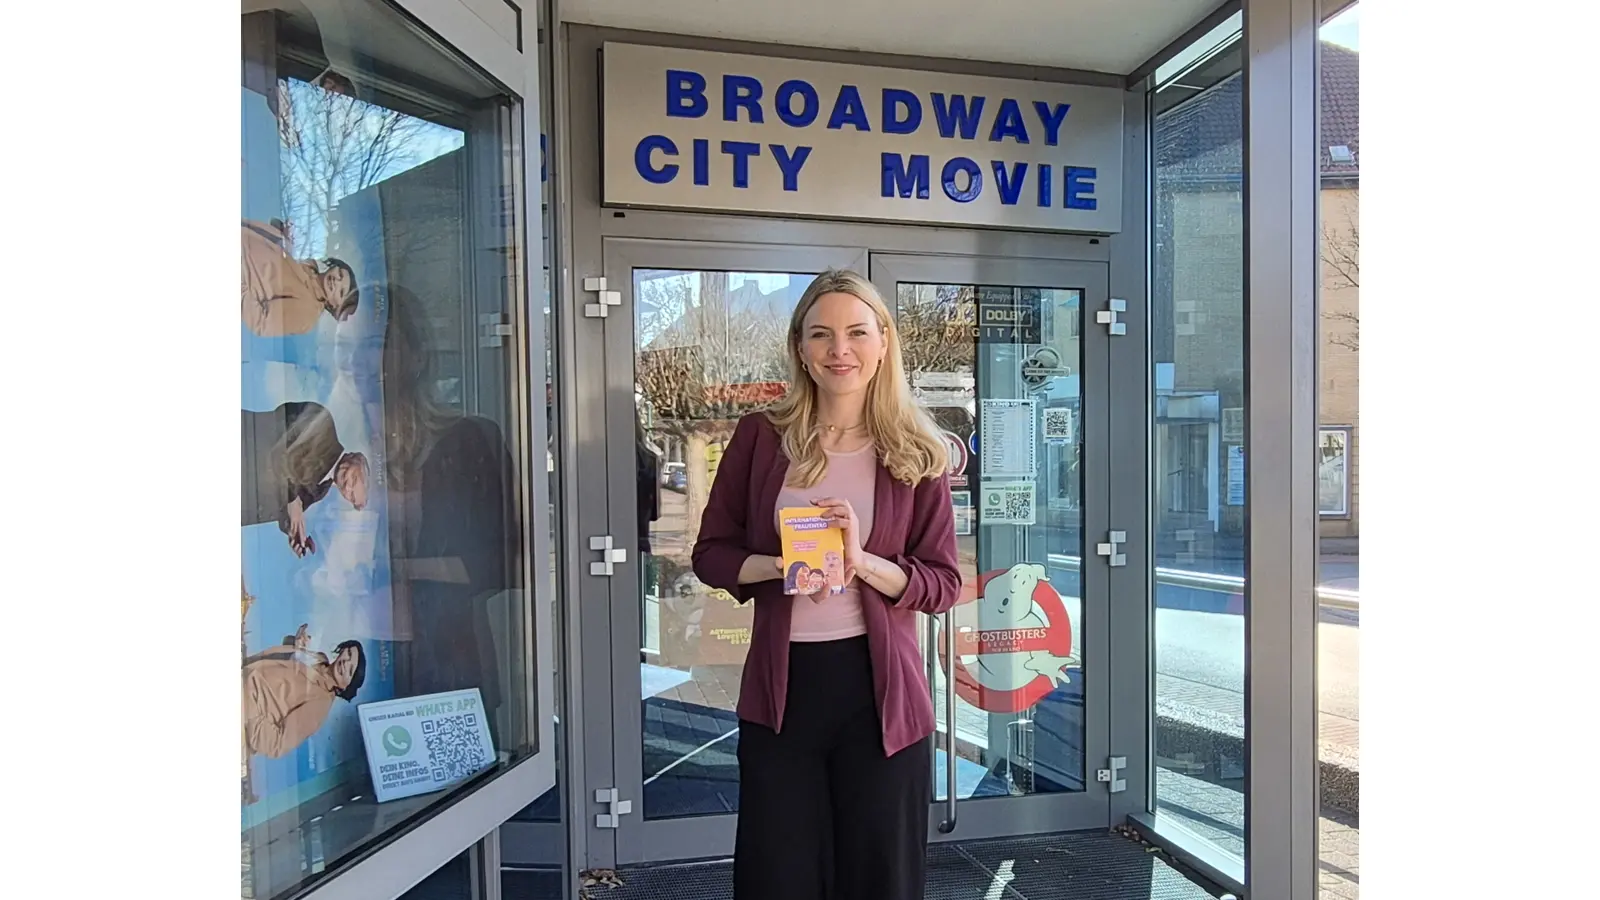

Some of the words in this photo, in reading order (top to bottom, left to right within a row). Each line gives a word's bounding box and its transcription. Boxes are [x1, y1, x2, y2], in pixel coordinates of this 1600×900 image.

[666, 69, 1071, 146] BROADWAY
[634, 135, 812, 192] CITY
[881, 152, 1097, 210] MOVIE
[986, 309, 1026, 321] DOLBY
[964, 628, 1047, 643] GHOSTBUSTERS
[415, 701, 454, 718] WHATS
[456, 698, 477, 712] APP
[380, 763, 398, 774] DEIN
[382, 770, 406, 783] DEINE
[405, 766, 429, 779] INFOS
